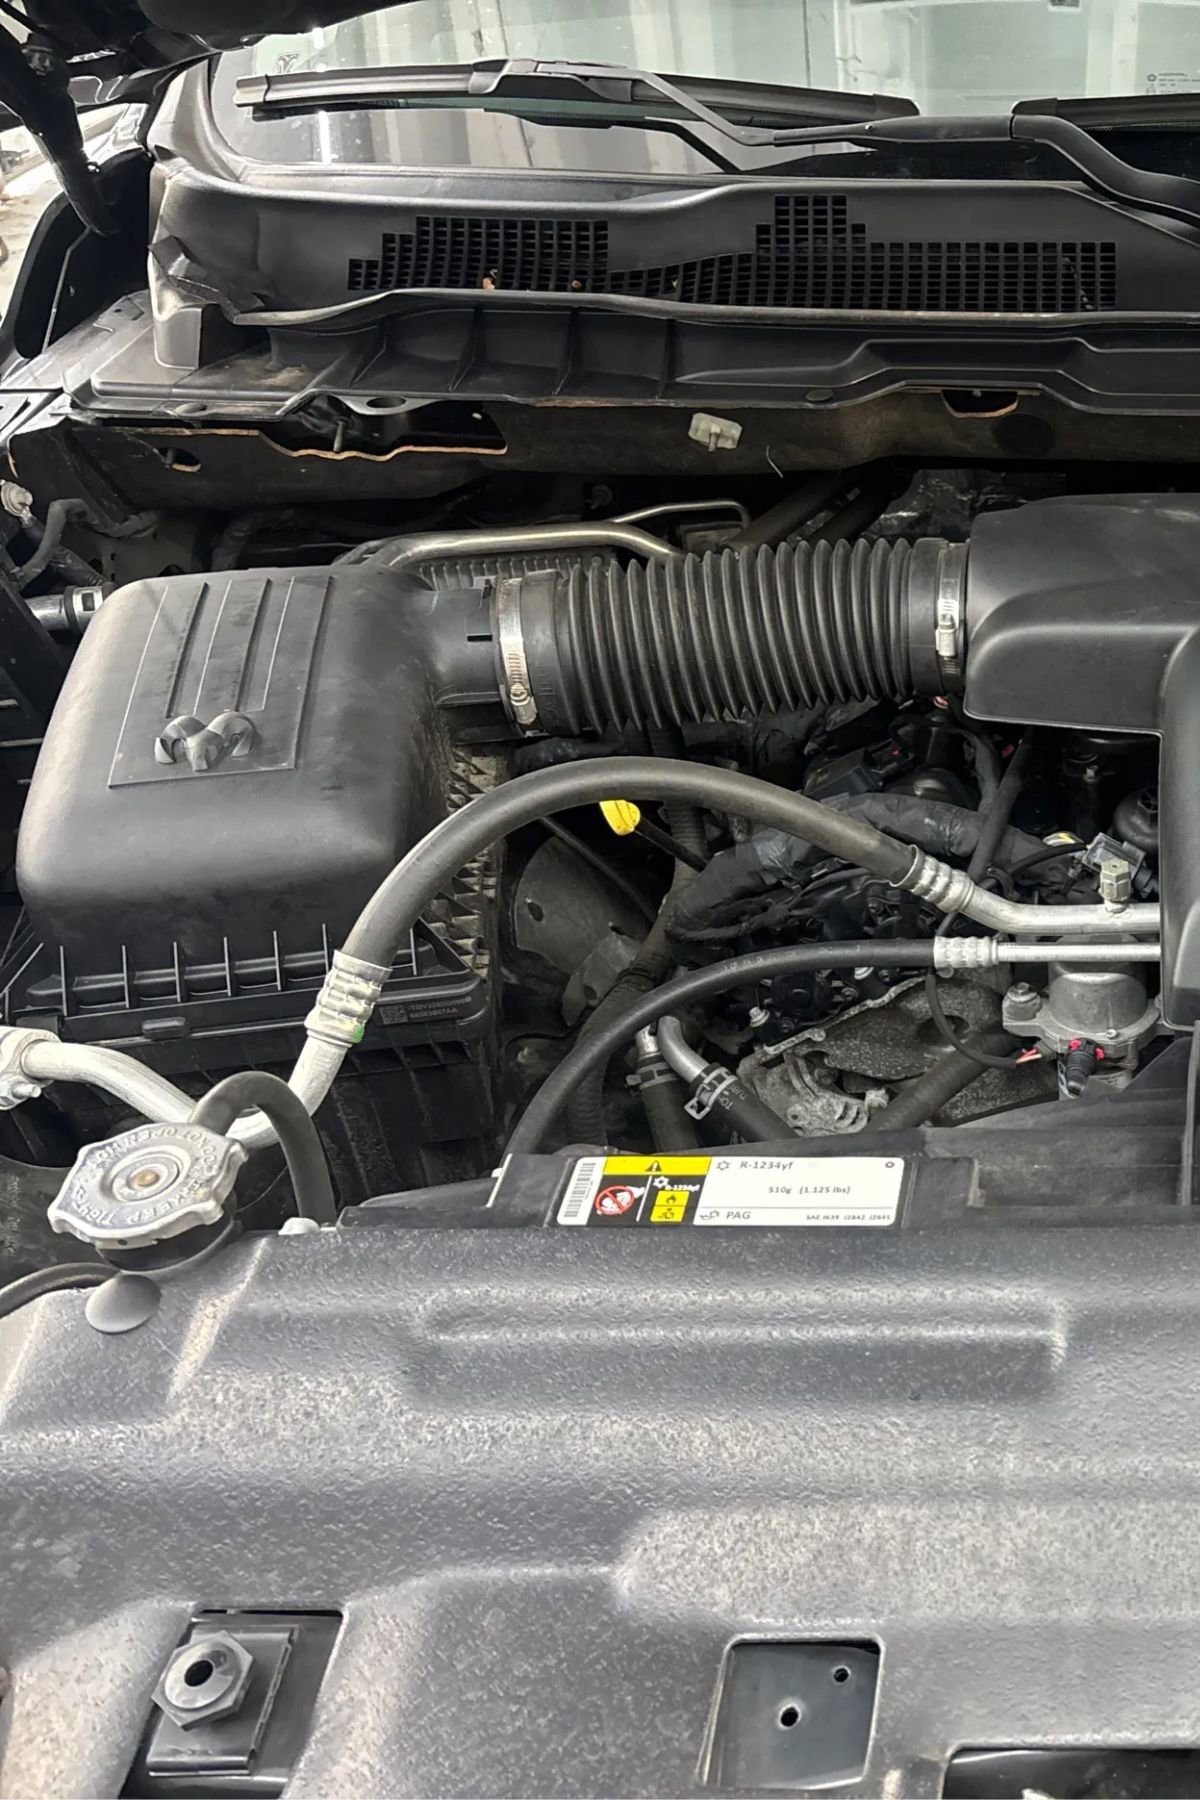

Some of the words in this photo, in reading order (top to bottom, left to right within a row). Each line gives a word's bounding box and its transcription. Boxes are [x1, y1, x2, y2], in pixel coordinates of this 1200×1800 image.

[740, 1160, 793, 1171] R-1234yf
[768, 1185, 792, 1195] 510g
[800, 1185, 830, 1195] (1.125
[832, 1185, 851, 1195] lbs)
[726, 1211, 751, 1220] PAG
